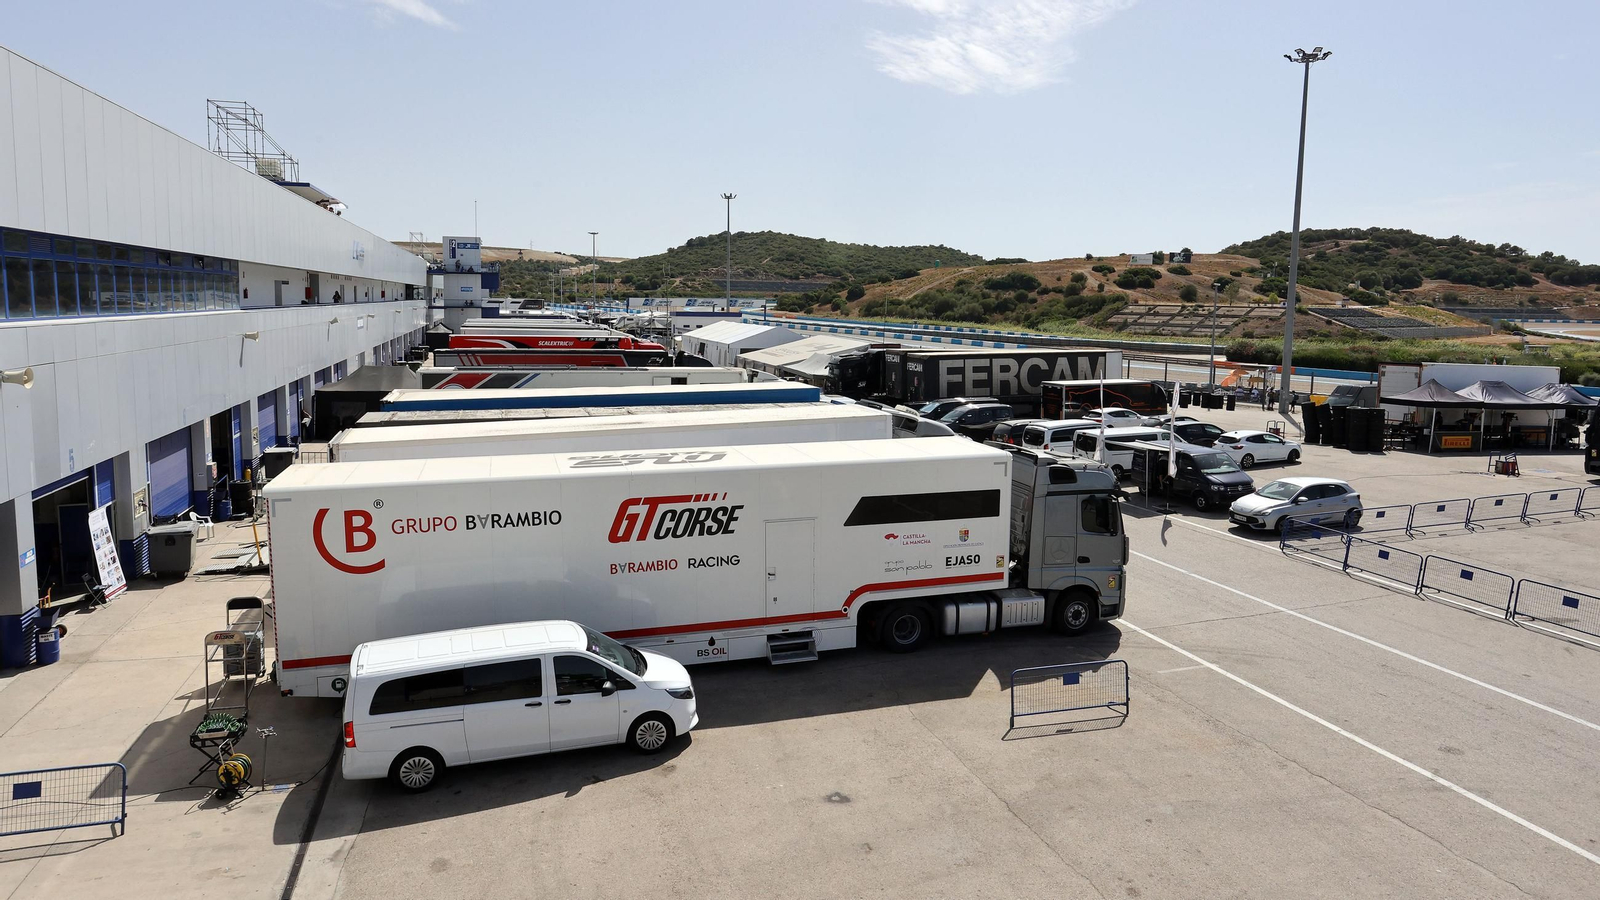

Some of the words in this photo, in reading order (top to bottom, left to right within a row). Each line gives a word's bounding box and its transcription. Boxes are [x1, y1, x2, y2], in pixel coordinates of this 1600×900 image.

[391, 516, 458, 535] GRUPO
[688, 555, 741, 569] RACING
[945, 554, 981, 567] EJASO
[696, 649, 710, 657] BS
[712, 648, 728, 656] OIL
